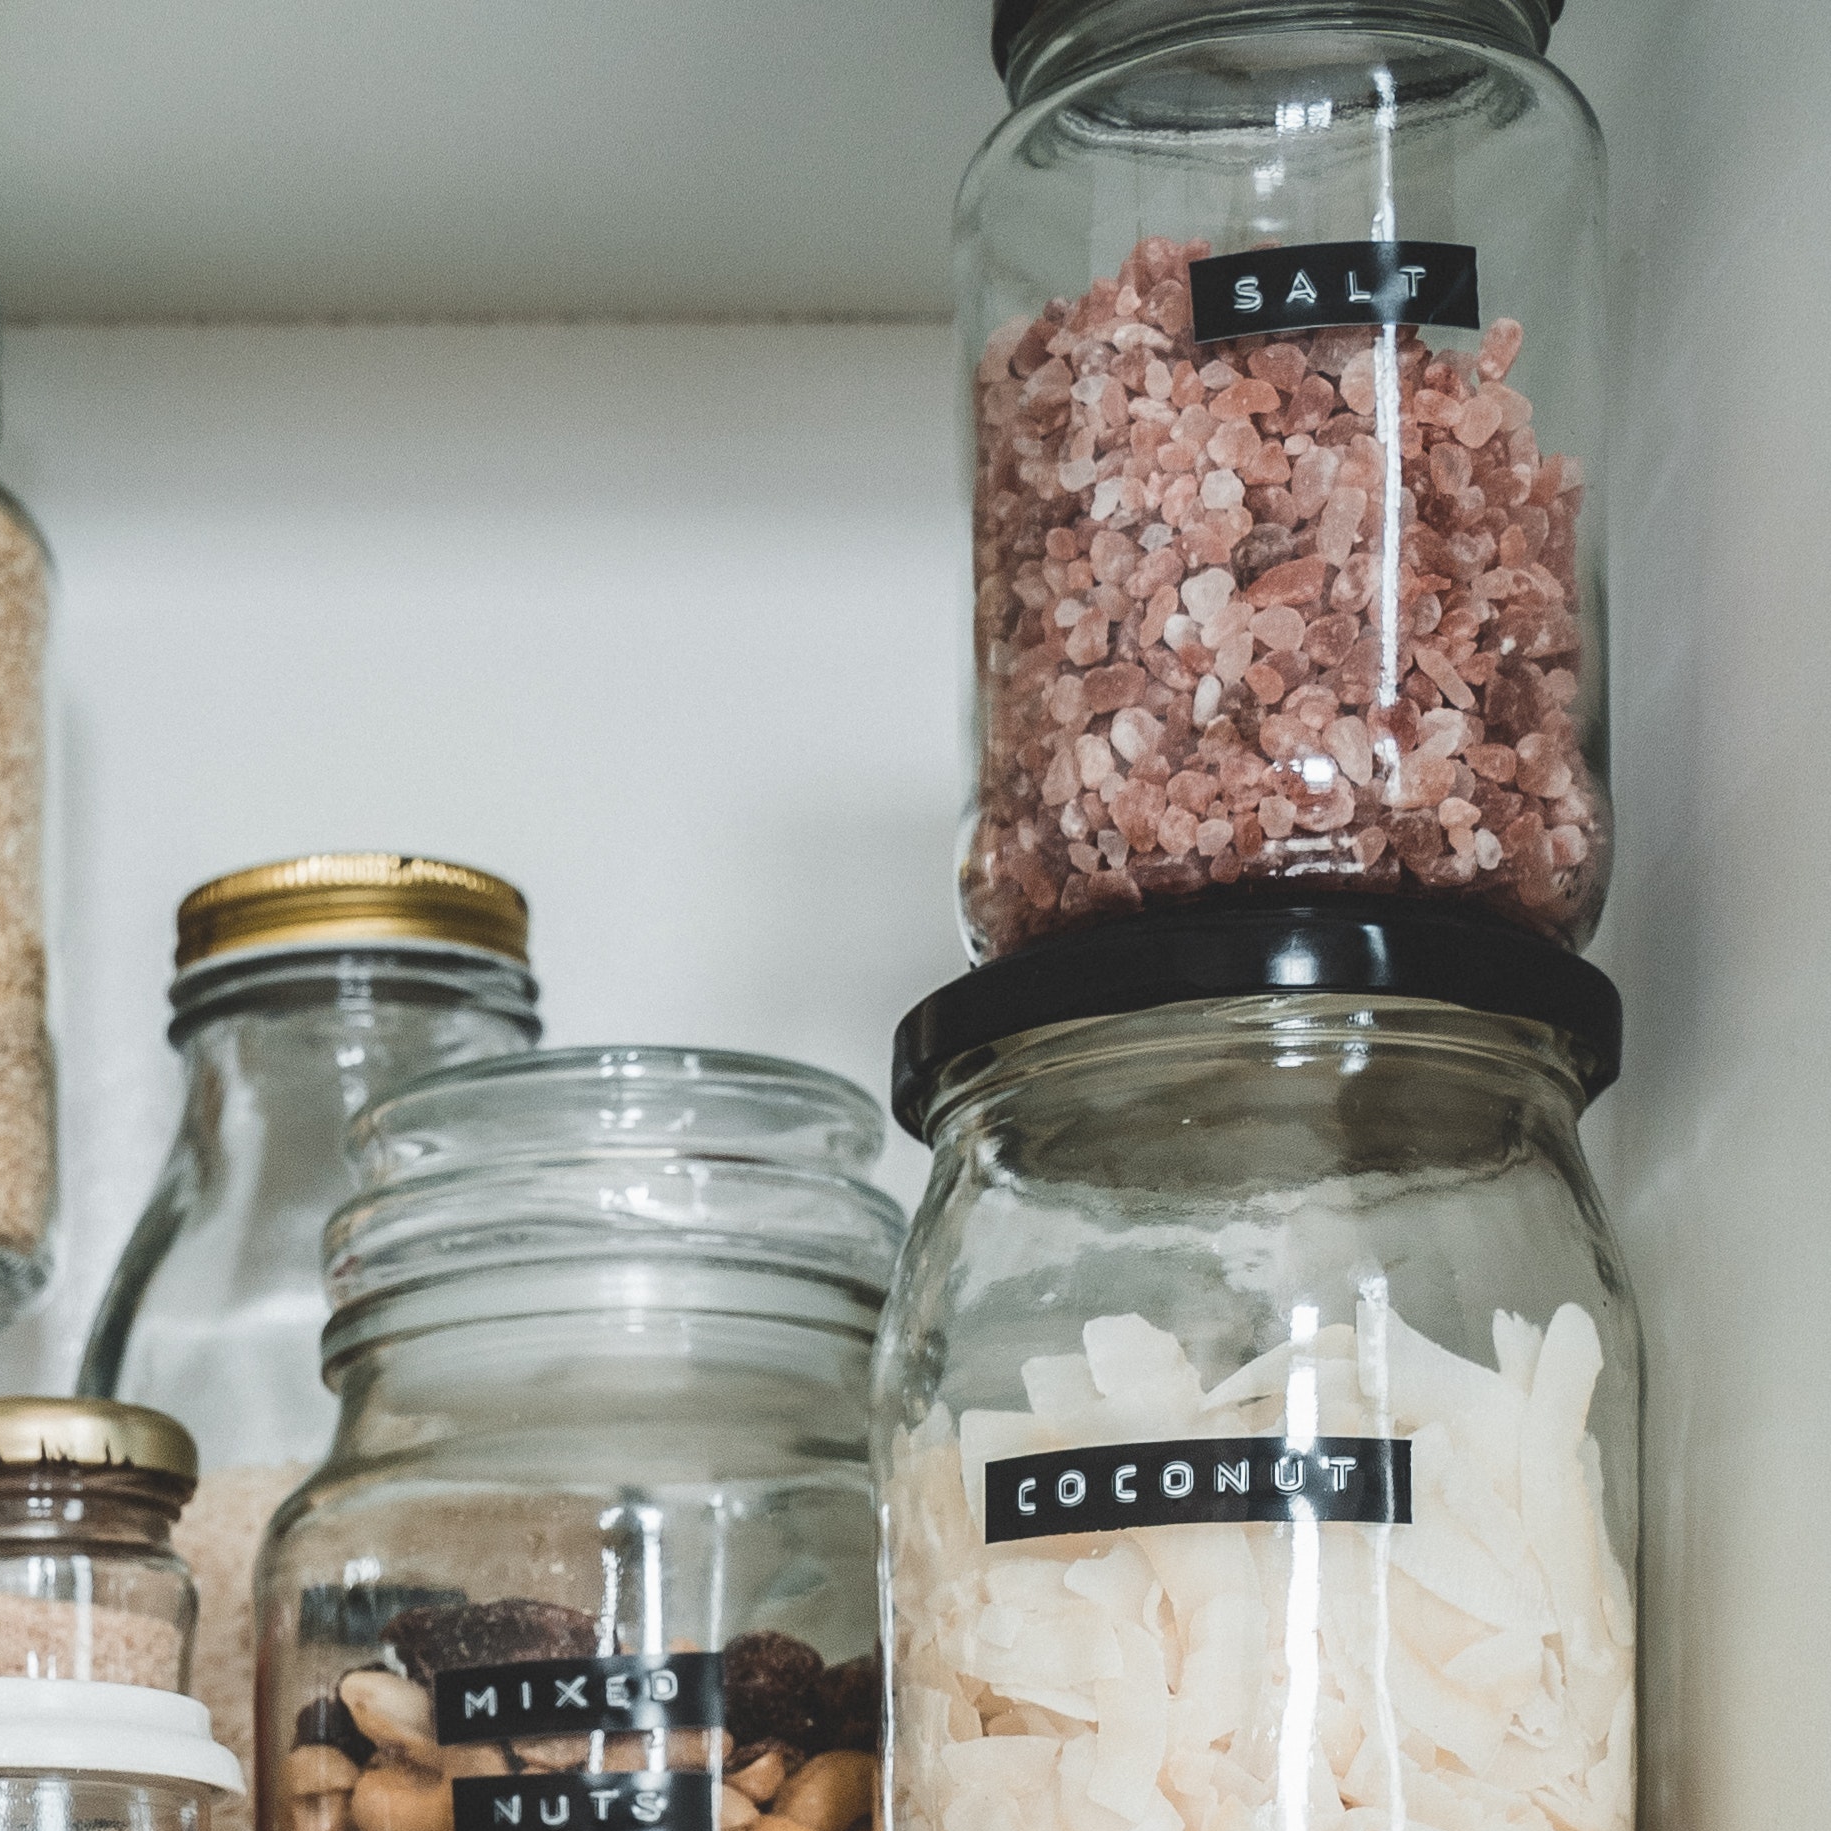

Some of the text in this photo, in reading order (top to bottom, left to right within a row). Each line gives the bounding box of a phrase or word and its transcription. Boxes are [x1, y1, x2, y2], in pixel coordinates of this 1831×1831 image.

[1232, 265, 1427, 313] SALT
[1017, 1455, 1358, 1515] COCONUT
[464, 1669, 679, 1718] MIXED
[493, 1789, 669, 1826] NUTS
